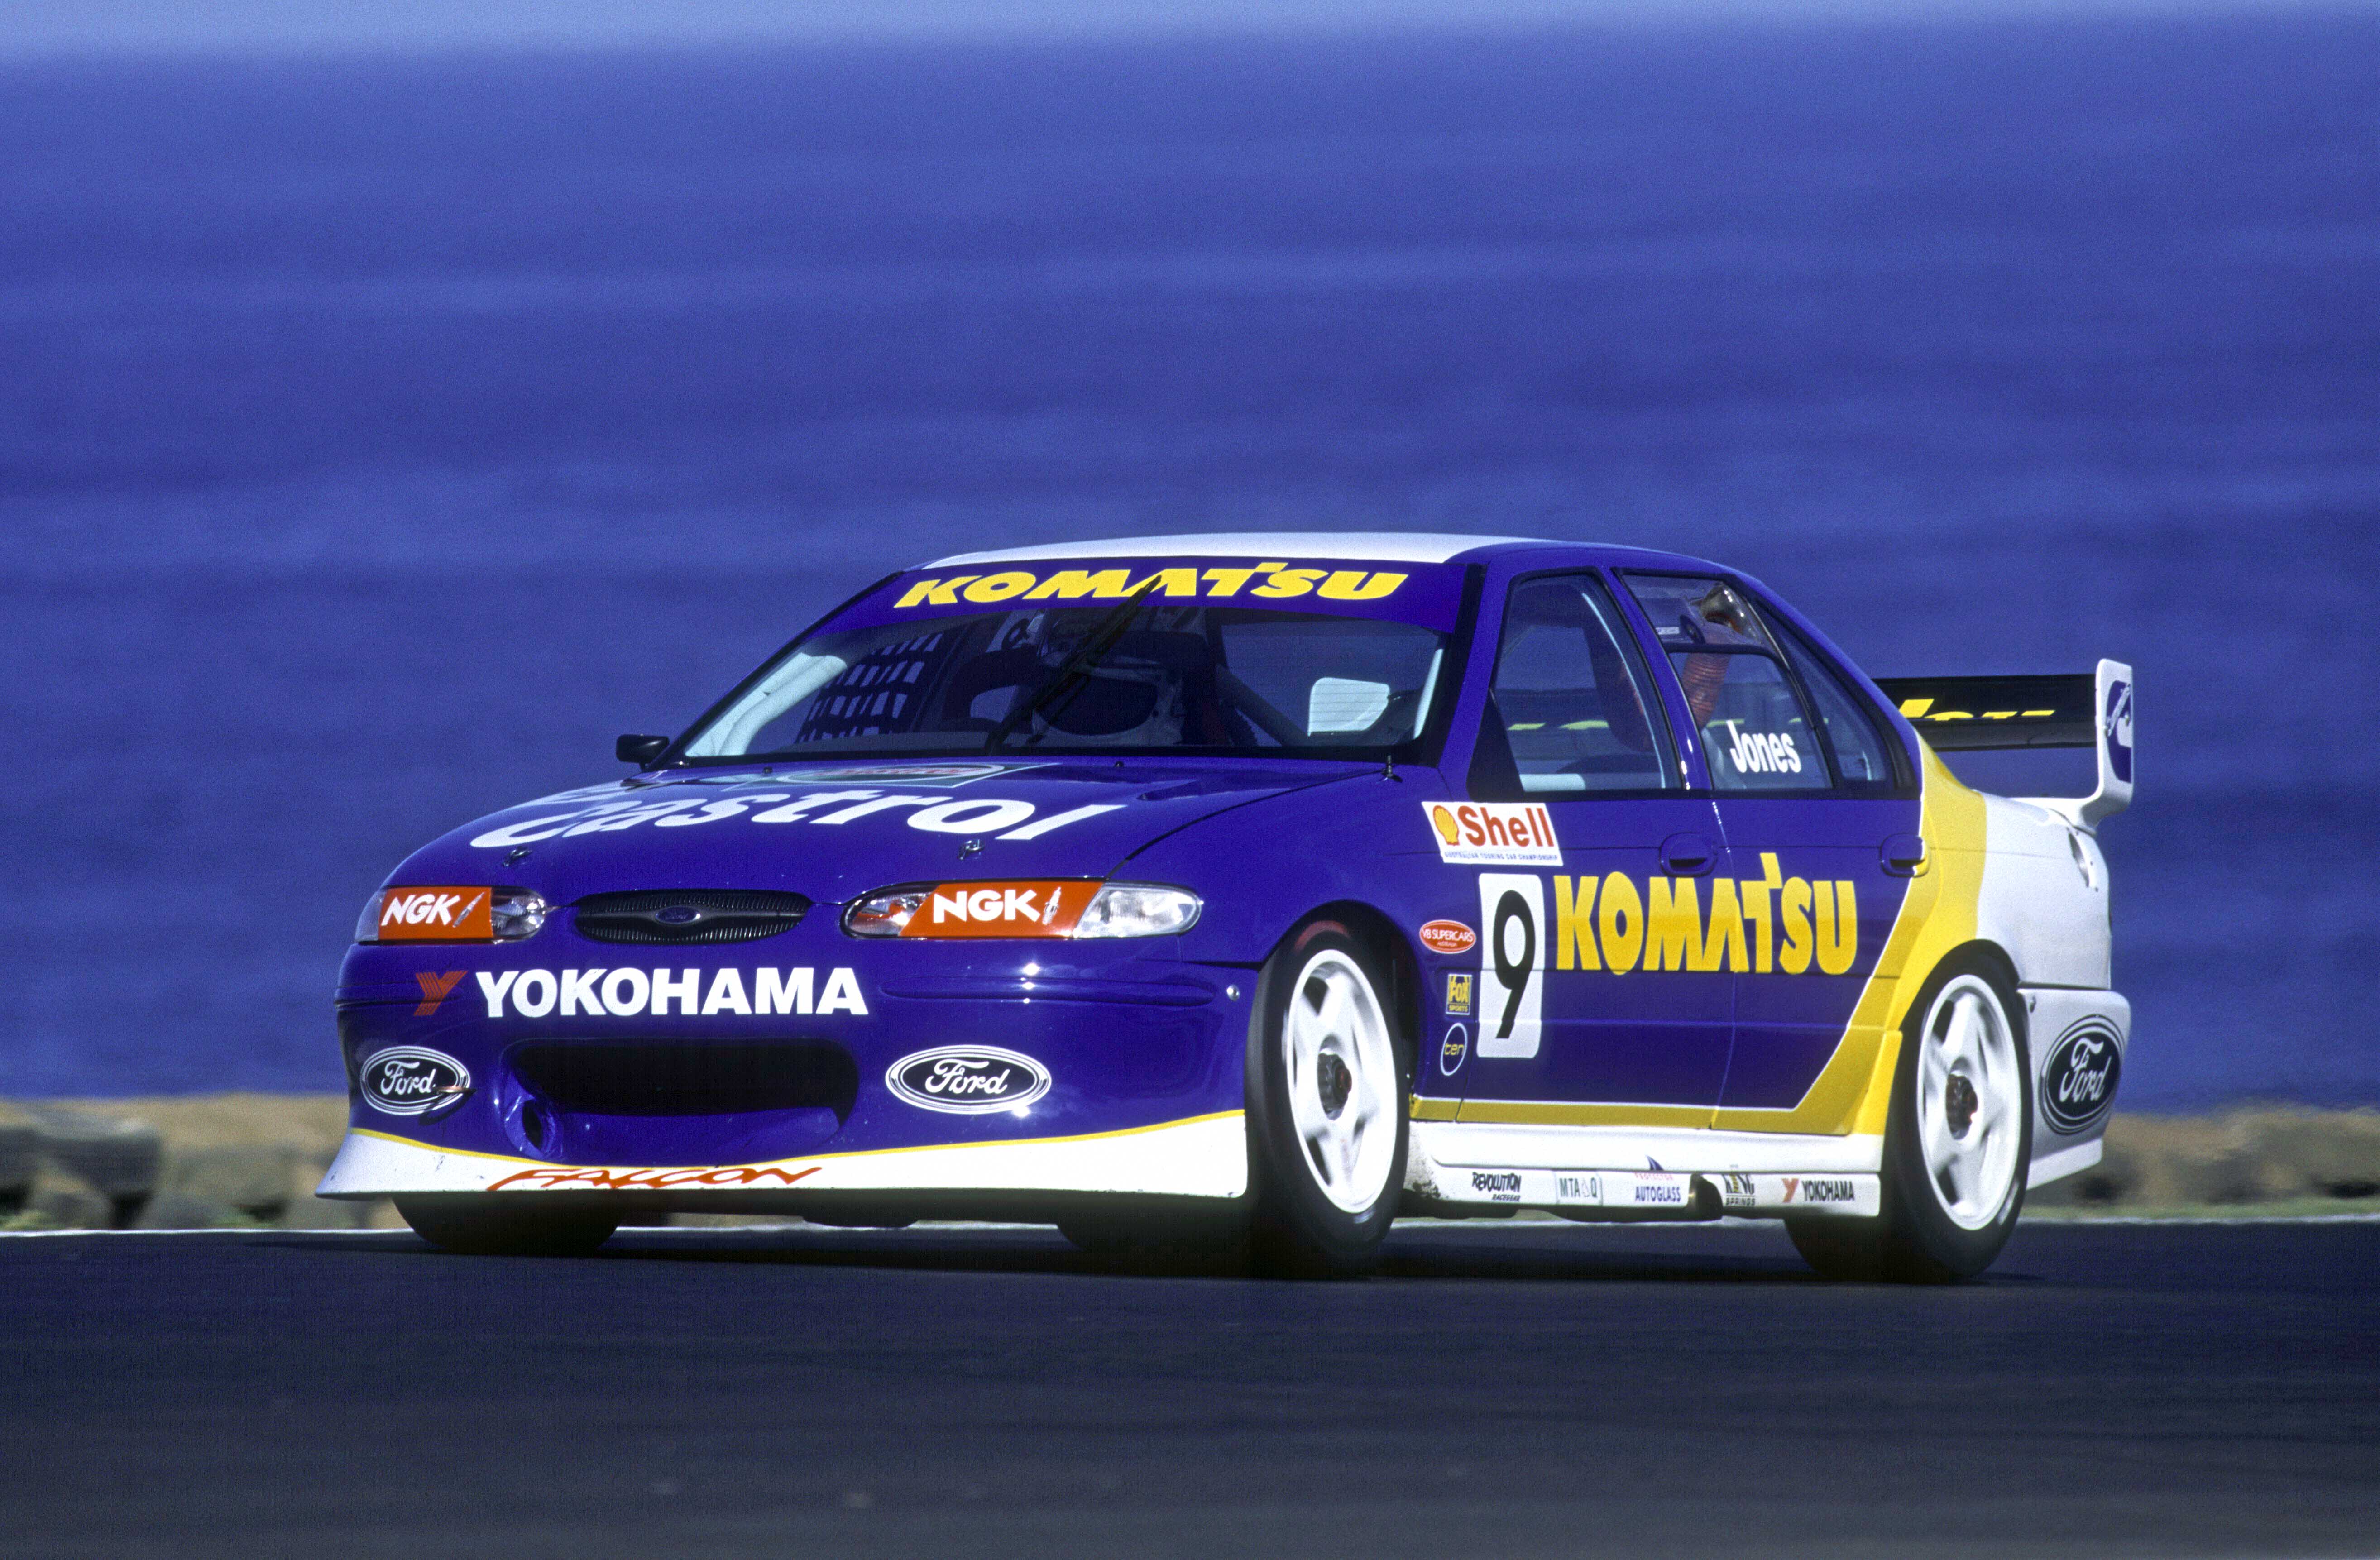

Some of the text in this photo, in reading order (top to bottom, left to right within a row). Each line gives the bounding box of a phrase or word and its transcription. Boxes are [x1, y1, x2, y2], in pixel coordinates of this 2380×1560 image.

[893, 562, 1408, 608] KOMATSU
[1726, 720, 1801, 773] Jones
[470, 790, 1128, 847] Castrol
[1457, 805, 1554, 847] Shell
[381, 893, 461, 926] NGK
[933, 889, 1041, 923] NGK
[1553, 852, 1858, 975] KOMATSU
[1422, 928, 1474, 942] V8 SUPERCARS
[1493, 890, 1536, 1039] 9
[476, 967, 869, 1018] YOKOHAMA
[1448, 981, 1470, 1003] FOX
[1444, 1043, 1464, 1056] ten
[381, 1060, 436, 1095] Ford
[925, 1059, 1010, 1094] Ford
[2059, 1037, 2112, 1102] Ford
[486, 1166, 822, 1190] FALCON
[1472, 1172, 1522, 1192] REVOLUTION
[1560, 1177, 1580, 1197] MTA
[1635, 1186, 1681, 1202] AUTOGLASS
[1802, 1180, 1854, 1201] YOKOHAMA
